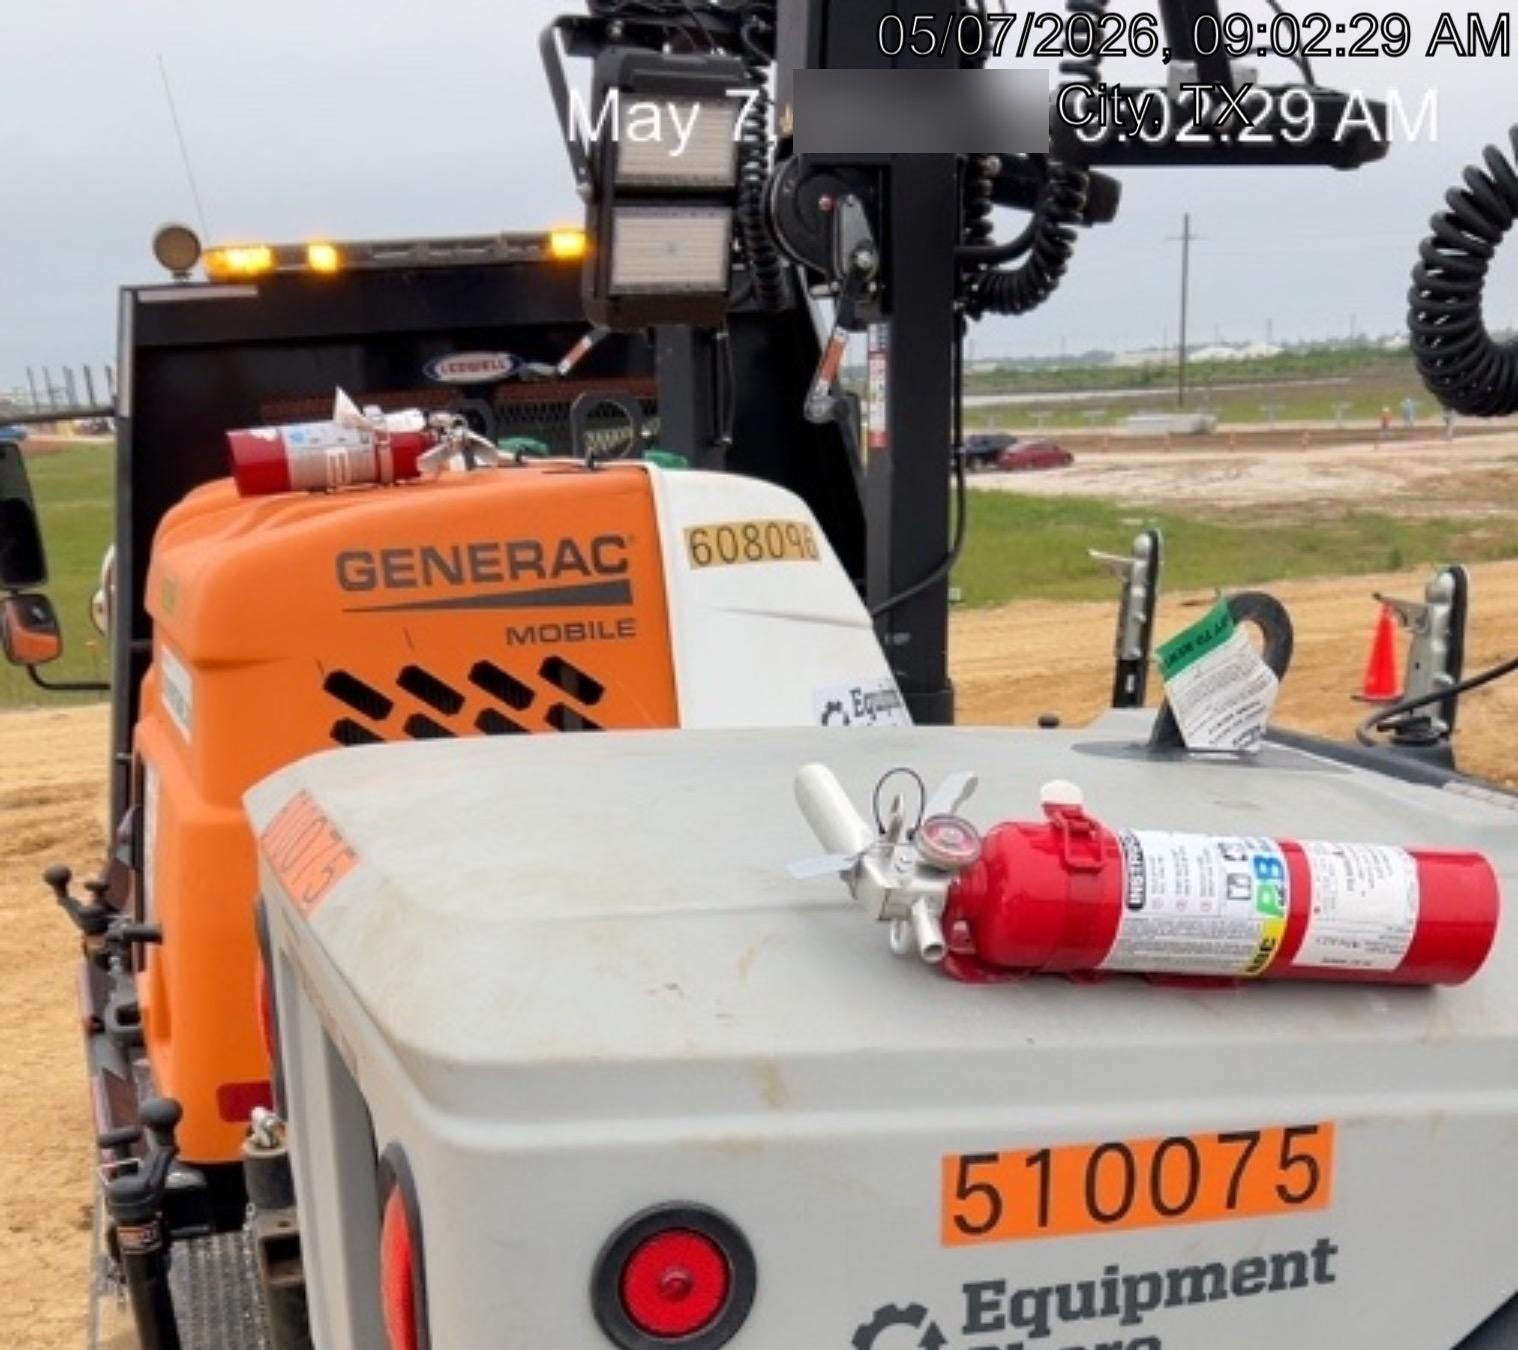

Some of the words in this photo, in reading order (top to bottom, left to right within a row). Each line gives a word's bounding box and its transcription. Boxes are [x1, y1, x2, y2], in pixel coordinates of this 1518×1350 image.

[335, 533, 631, 593] GENERAC
[689, 520, 818, 565] 608096
[505, 617, 637, 647] MOBILE
[952, 1124, 1321, 1236] 510075
[961, 1237, 1339, 1338] Equipment
